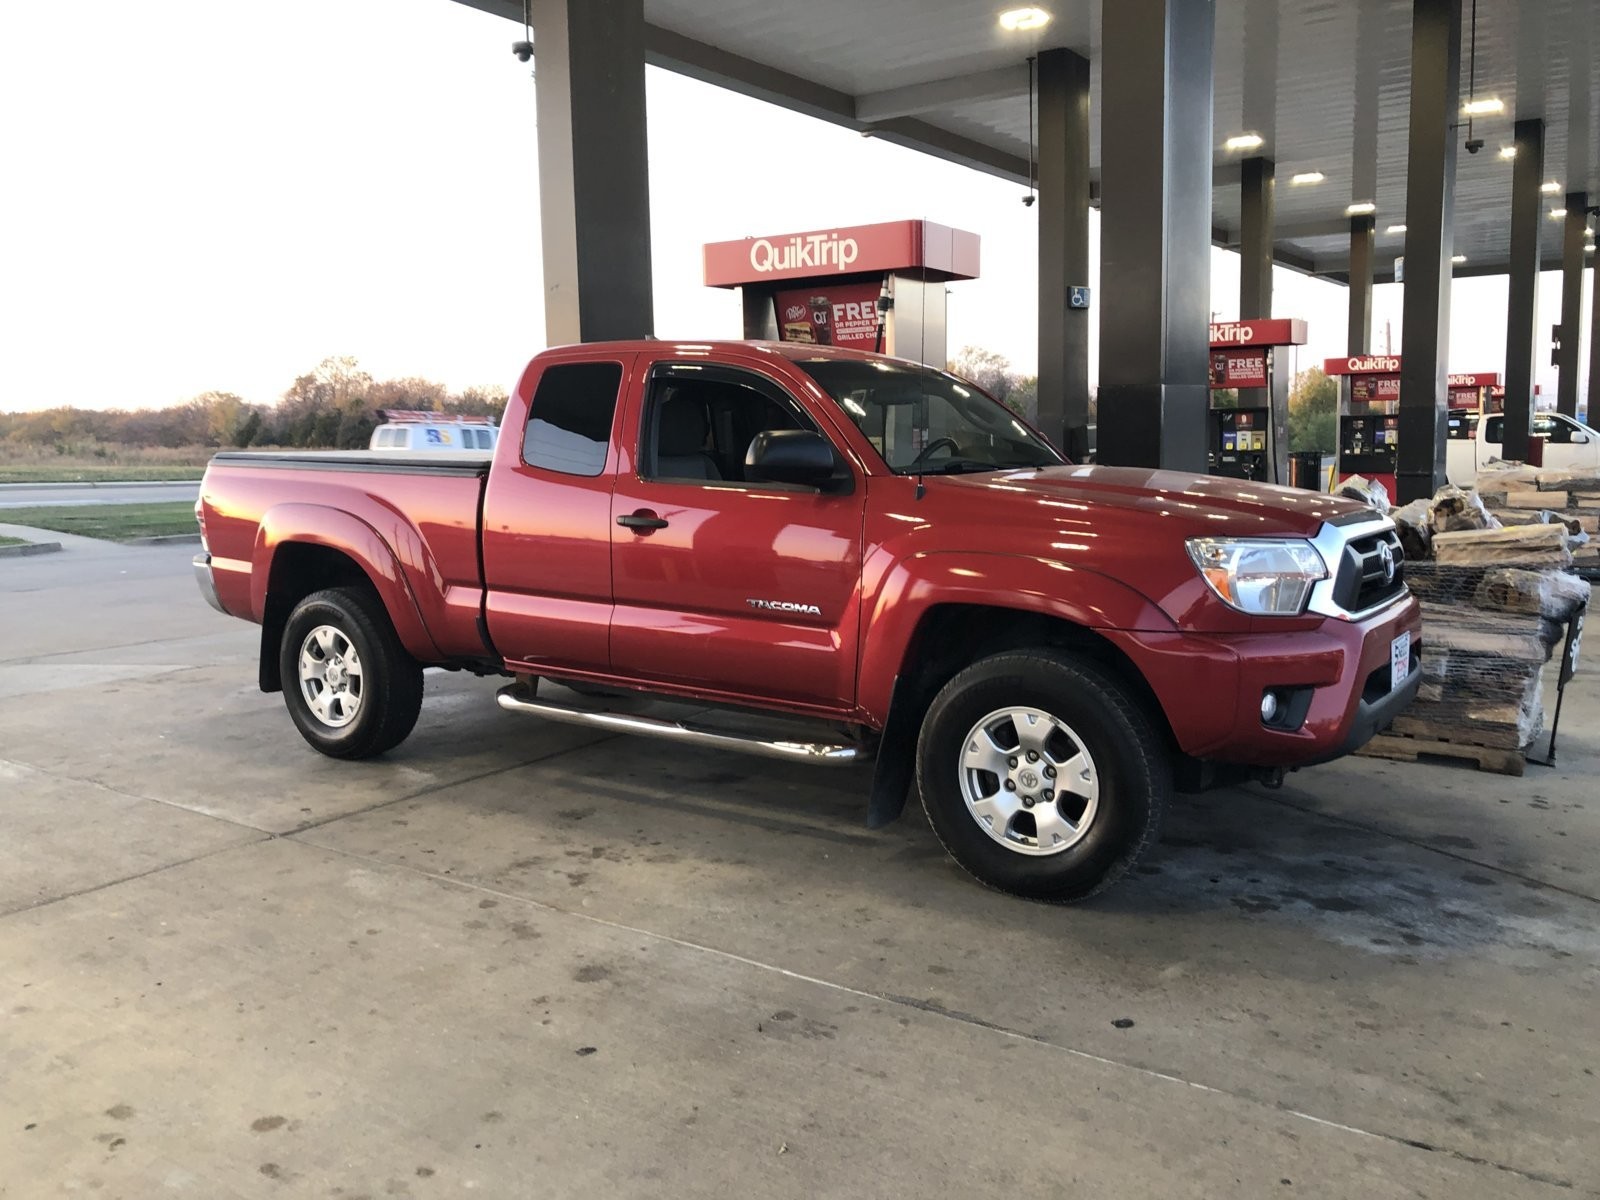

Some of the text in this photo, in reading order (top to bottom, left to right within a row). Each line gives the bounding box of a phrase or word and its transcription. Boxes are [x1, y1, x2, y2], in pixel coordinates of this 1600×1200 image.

[750, 233, 858, 272] QuikTrip
[813, 311, 827, 325] QT
[836, 332, 864, 341] GRILLED
[1210, 323, 1253, 344] ikTrip
[1228, 357, 1263, 369] FREE
[1348, 357, 1399, 371] QuikTrip
[1448, 375, 1475, 386] ikTrip
[746, 599, 822, 615] TACOMA
